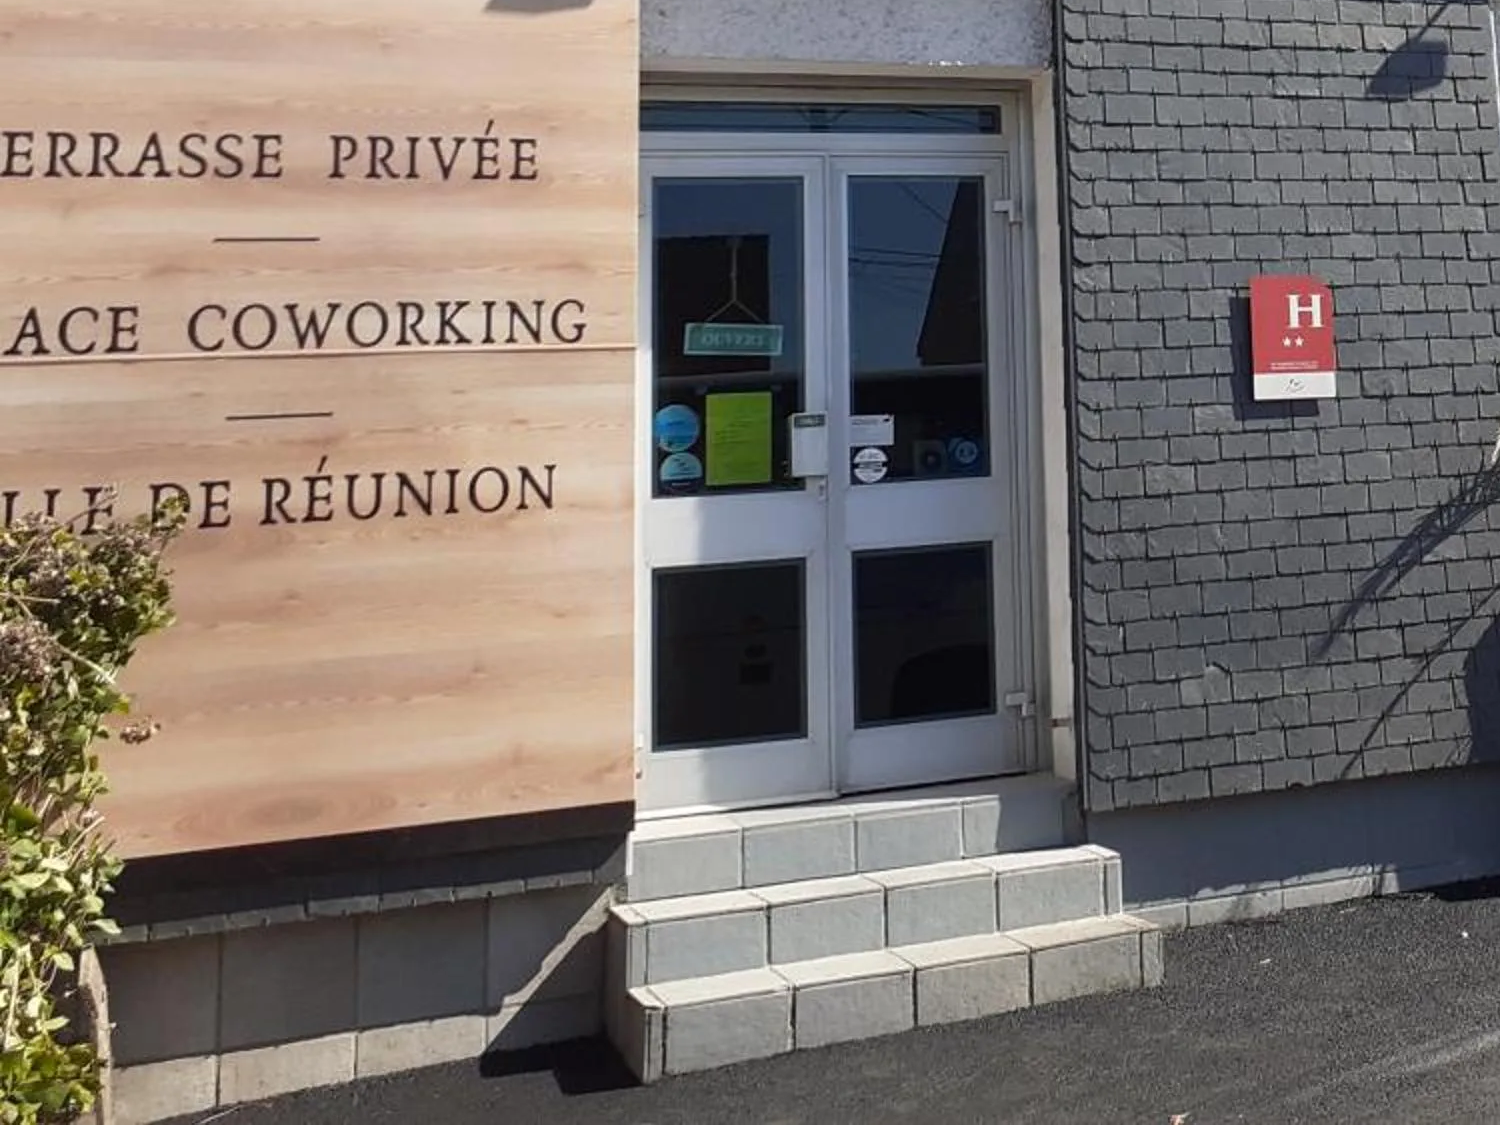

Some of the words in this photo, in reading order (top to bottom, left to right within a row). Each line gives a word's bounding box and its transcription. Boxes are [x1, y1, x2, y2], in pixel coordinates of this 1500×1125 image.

[329, 120, 540, 181] PRIVÉE
[187, 298, 588, 352] COWORKING
[1287, 294, 1324, 328] H
[260, 455, 557, 528] RÉUNION
